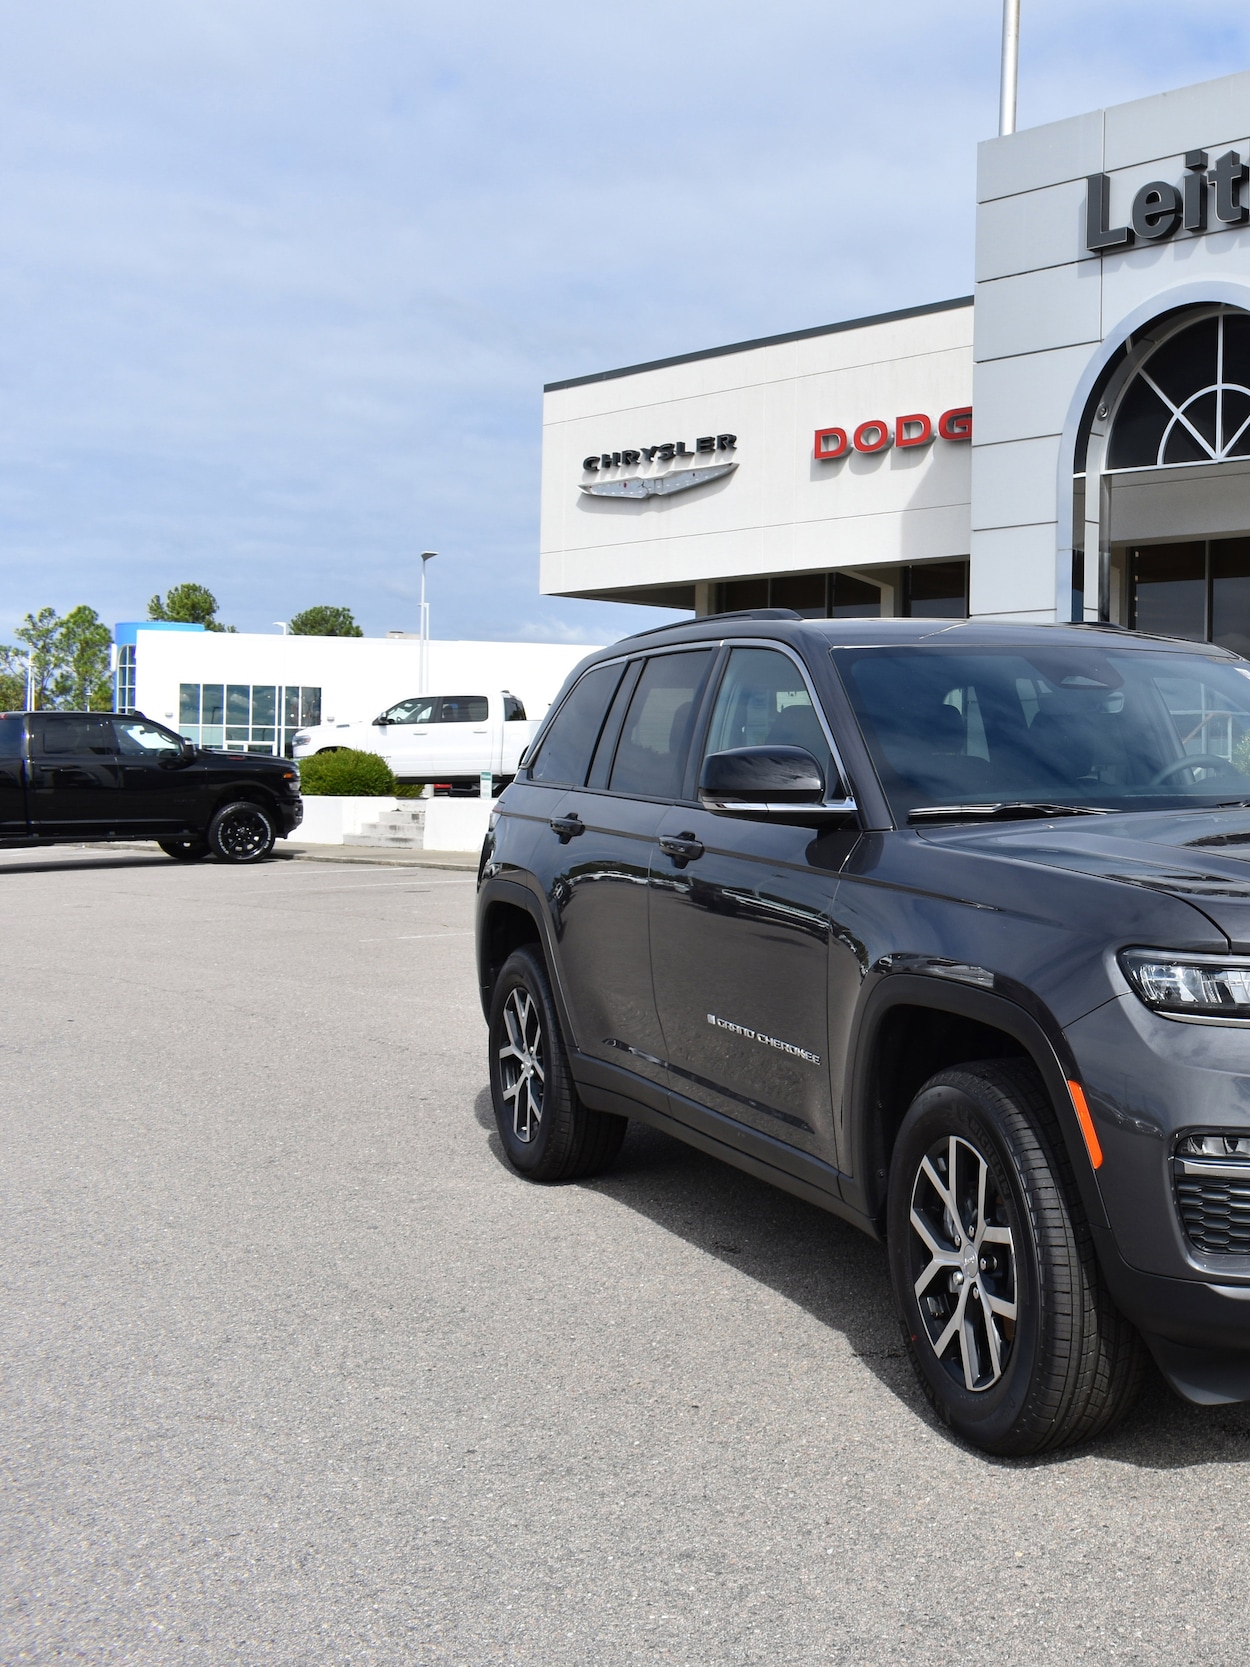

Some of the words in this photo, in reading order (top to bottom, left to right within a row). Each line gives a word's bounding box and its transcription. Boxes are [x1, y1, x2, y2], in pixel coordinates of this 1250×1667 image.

[583, 433, 737, 471] CHRYSLER
[814, 406, 972, 460] DODG
[717, 1018, 755, 1039] GRAND
[756, 1033, 822, 1066] CHEROKEE
[966, 1117, 1011, 1198] MICHELIN
